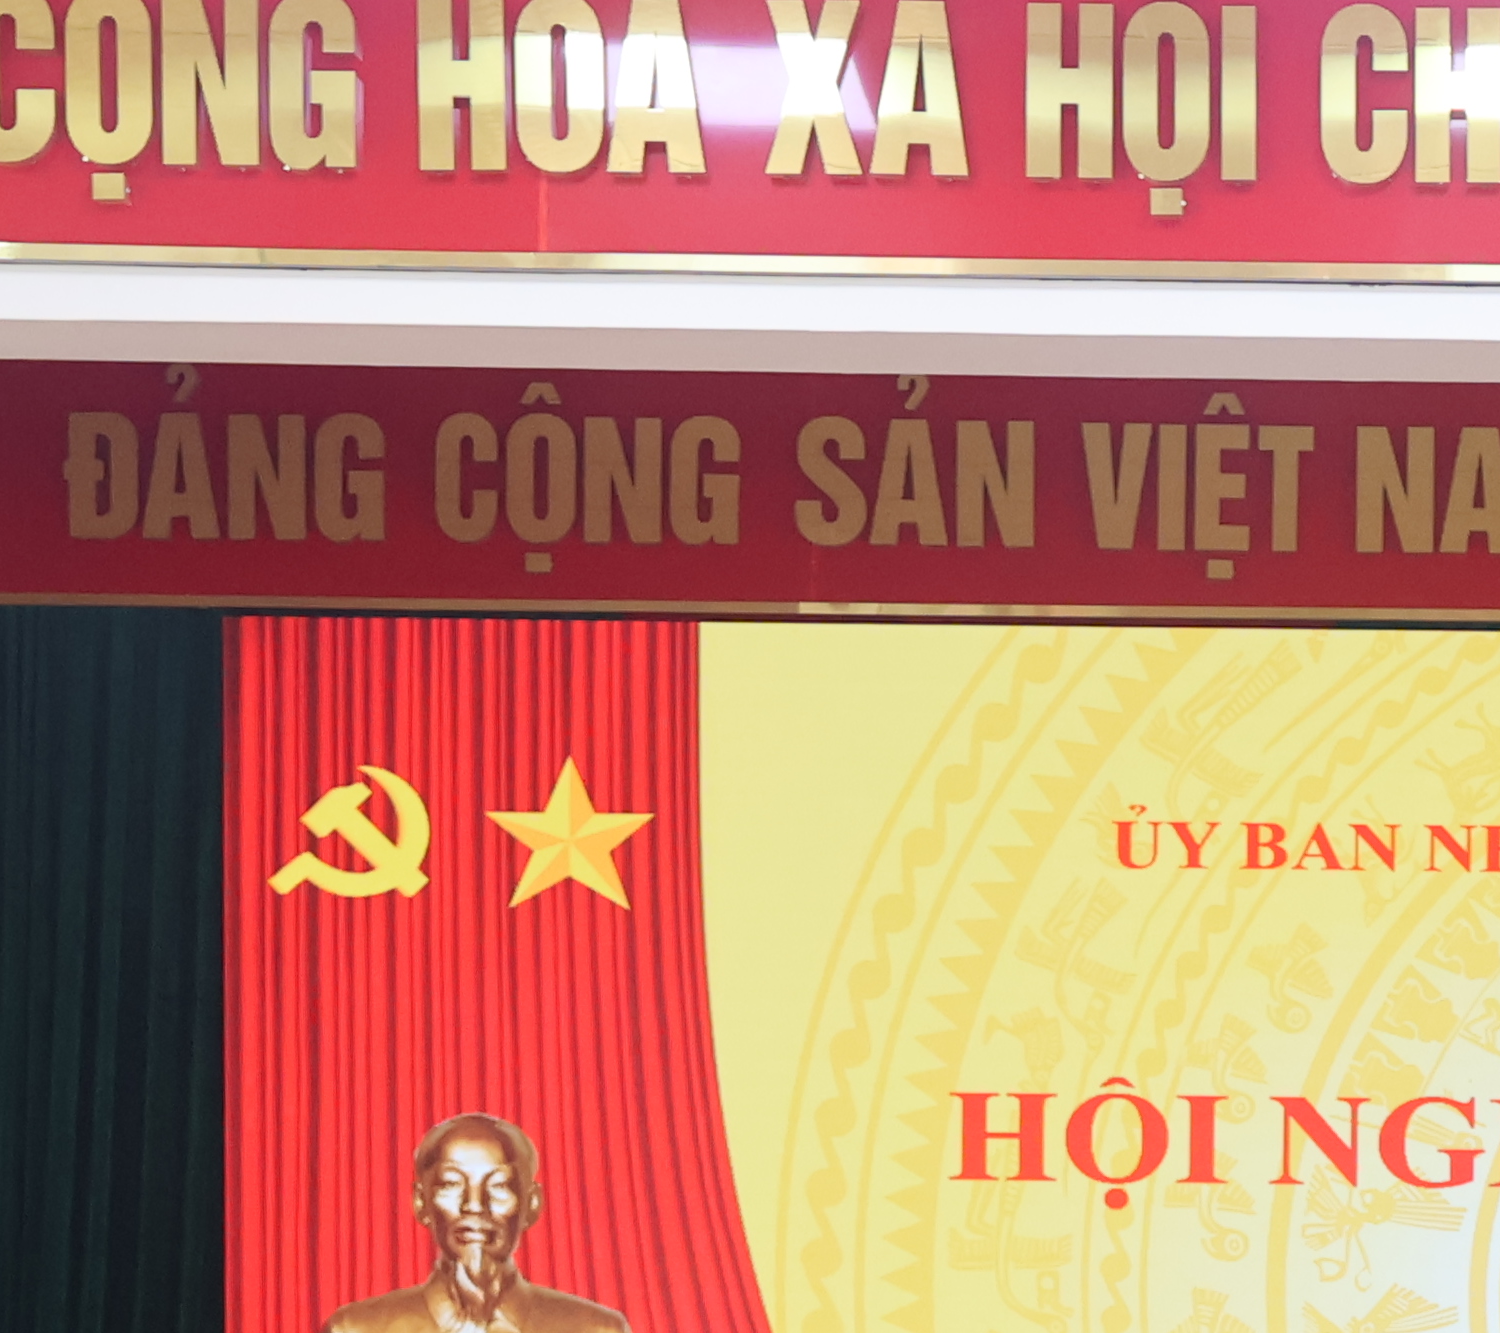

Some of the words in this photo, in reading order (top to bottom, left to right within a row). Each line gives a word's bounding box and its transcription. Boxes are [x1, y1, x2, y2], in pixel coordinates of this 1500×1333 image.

[63, 363, 386, 542] ĐẢNG
[433, 382, 741, 574] CỘNG
[794, 374, 1035, 548] SẢN
[1081, 392, 1315, 580] VIỆT
[1115, 806, 1218, 869] ỦY
[1244, 823, 1398, 870] BAN
[952, 1077, 1226, 1209] HỘI
